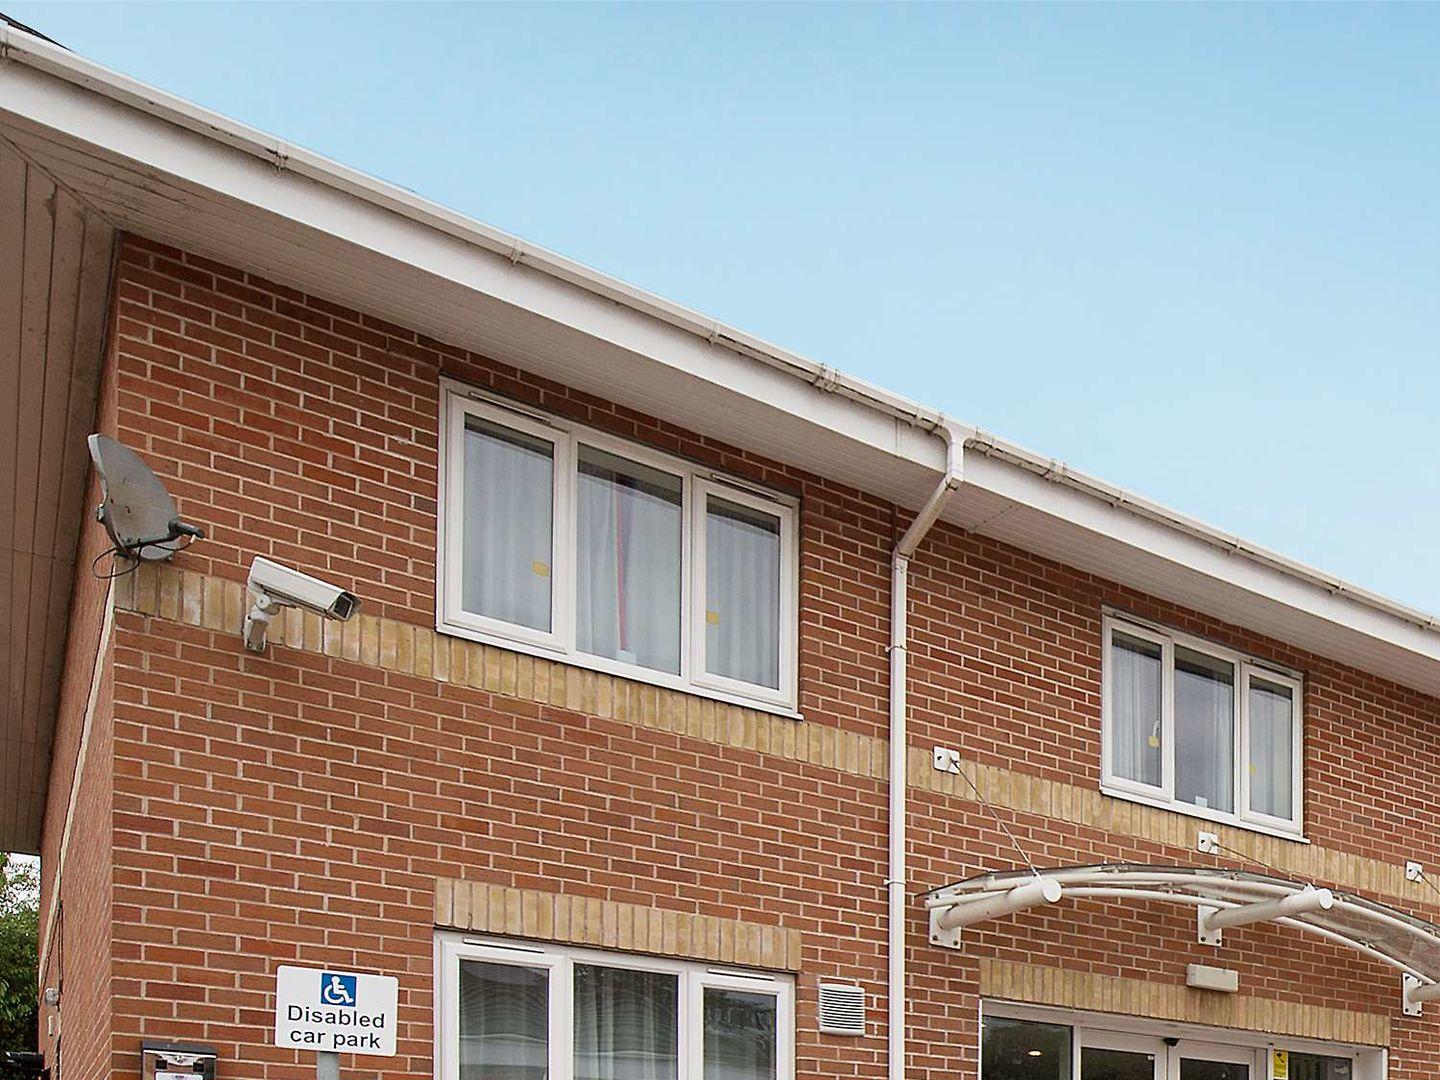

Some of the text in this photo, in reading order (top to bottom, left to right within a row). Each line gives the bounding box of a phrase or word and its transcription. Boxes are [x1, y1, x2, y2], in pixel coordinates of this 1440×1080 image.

[287, 1005, 385, 1028] Disabled
[290, 1030, 381, 1049] car park
